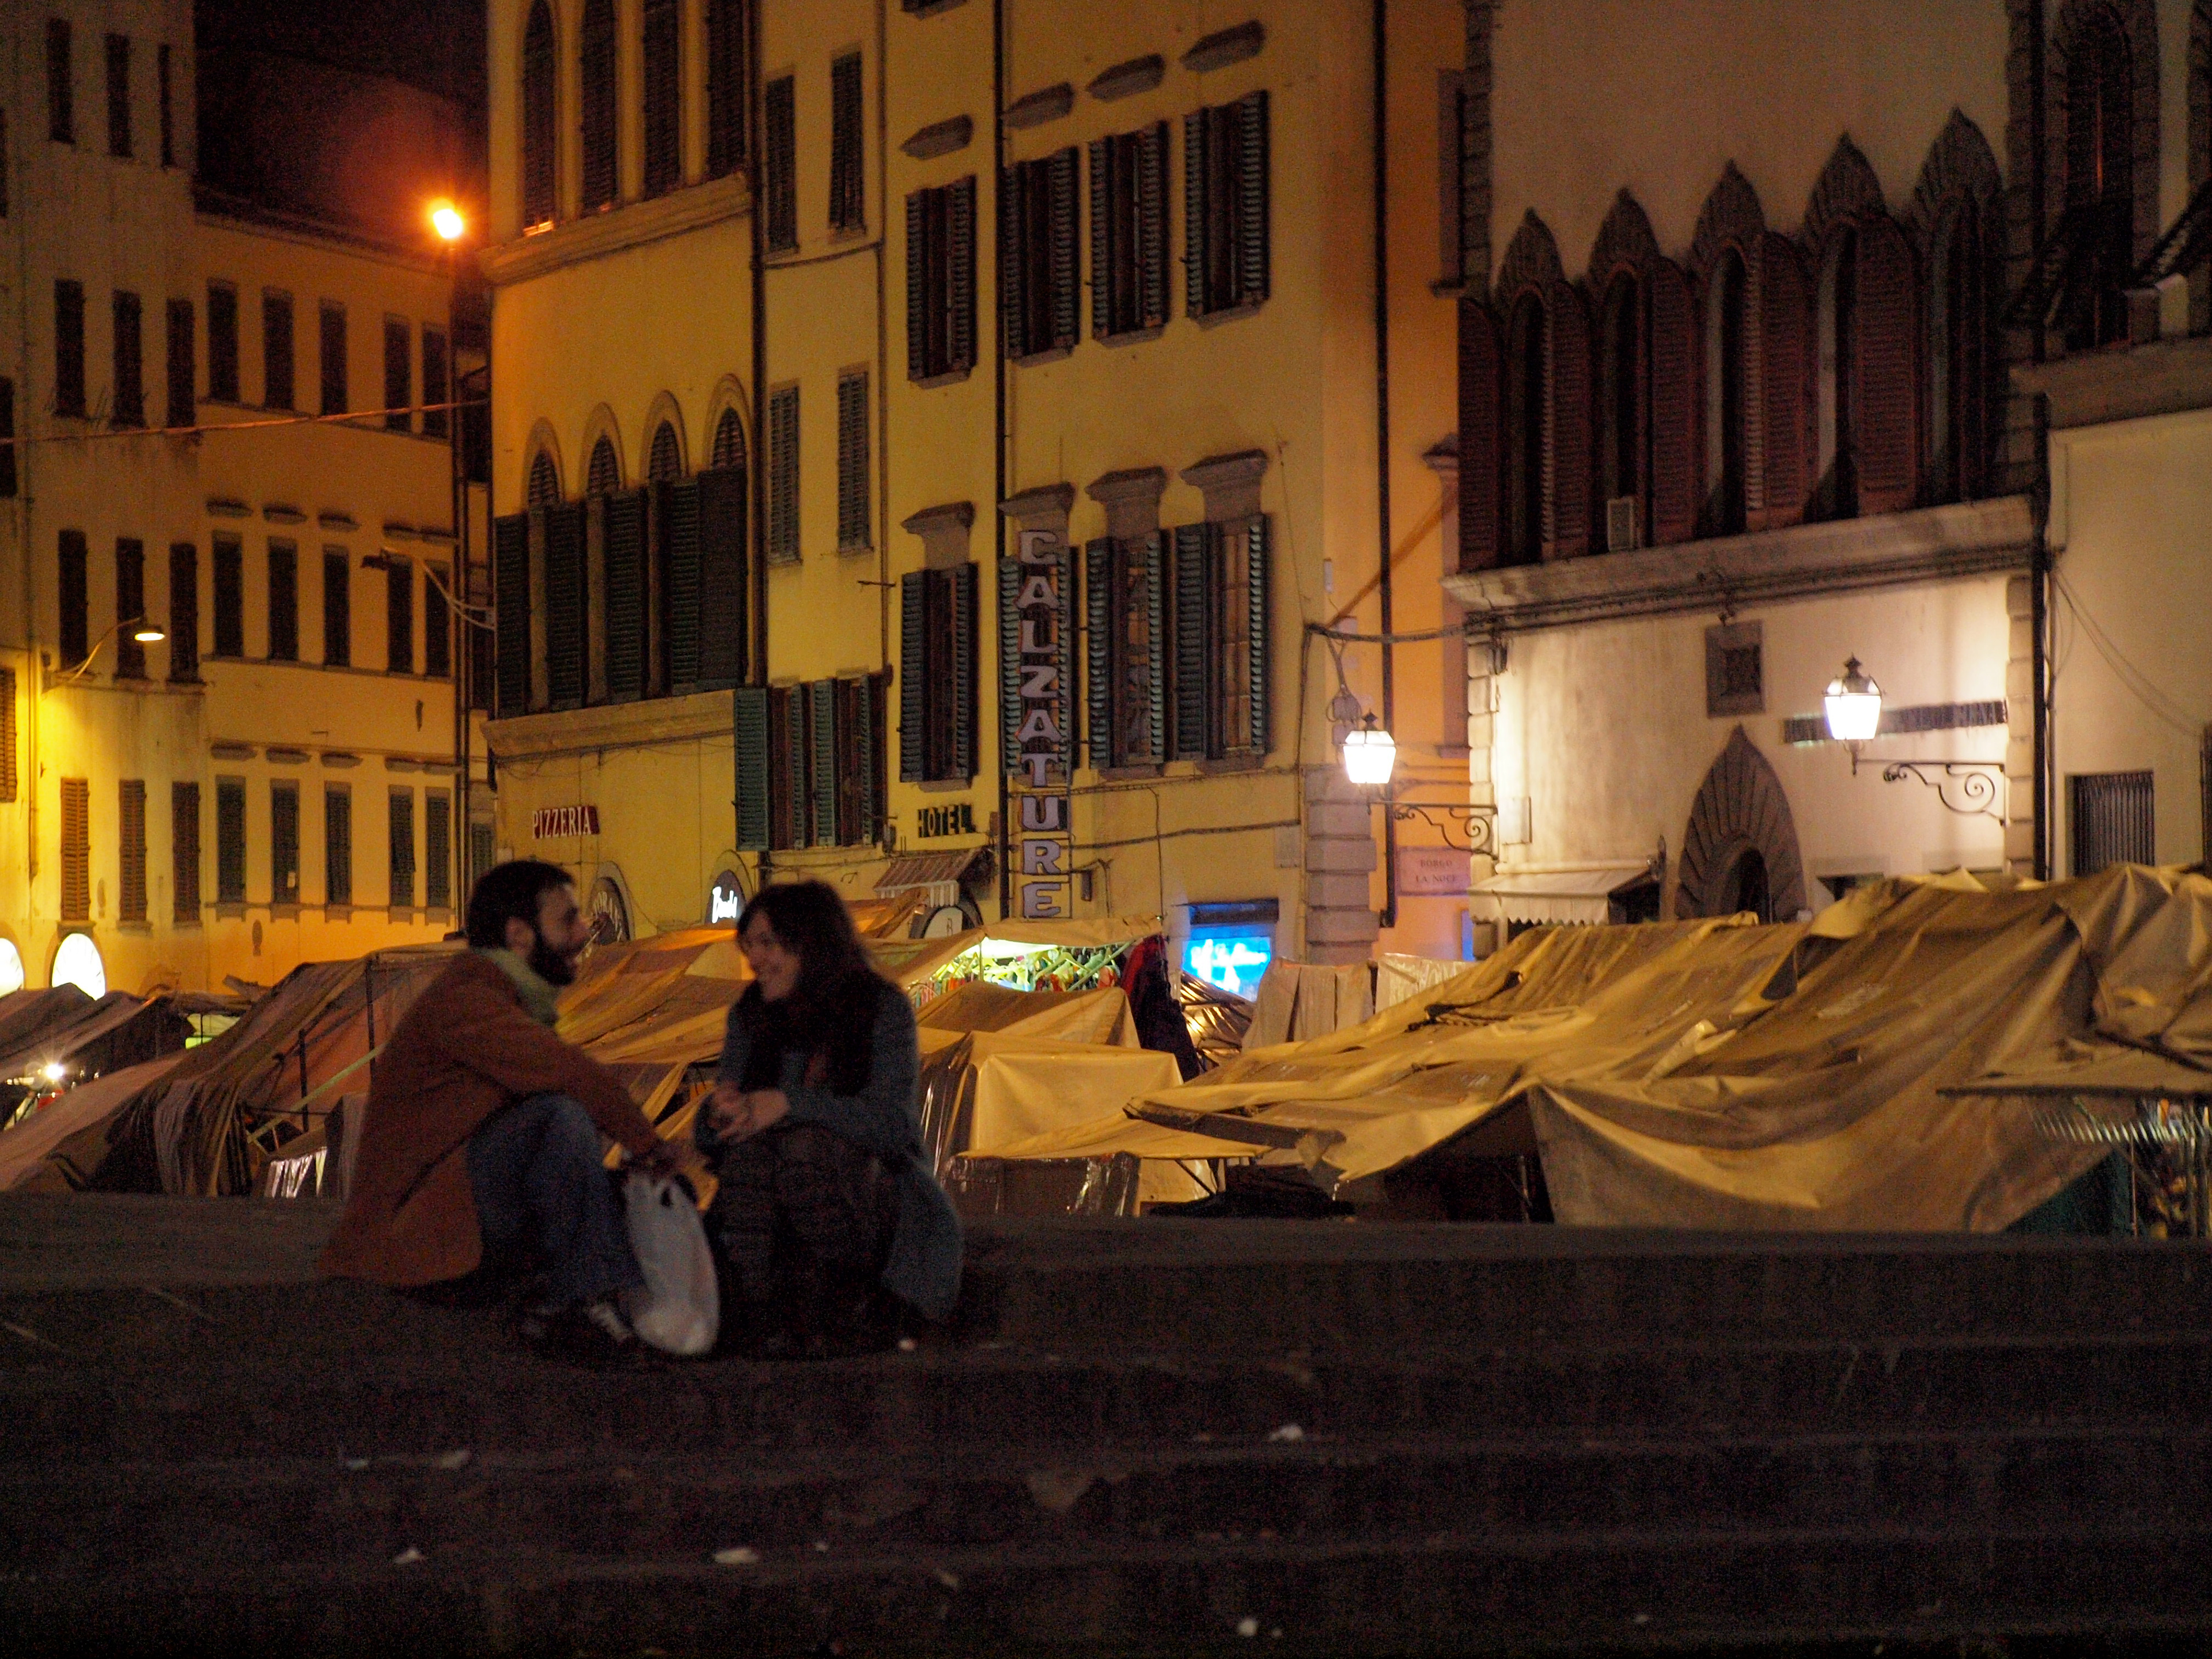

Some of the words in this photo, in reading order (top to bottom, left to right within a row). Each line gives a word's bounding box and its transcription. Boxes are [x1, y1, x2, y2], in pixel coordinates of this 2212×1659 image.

[1014, 531, 1062, 918] CALZATURE
[532, 806, 592, 839] PIZZERIA
[918, 804, 970, 838] HOTEL
[1420, 859, 1453, 868] BORGO
